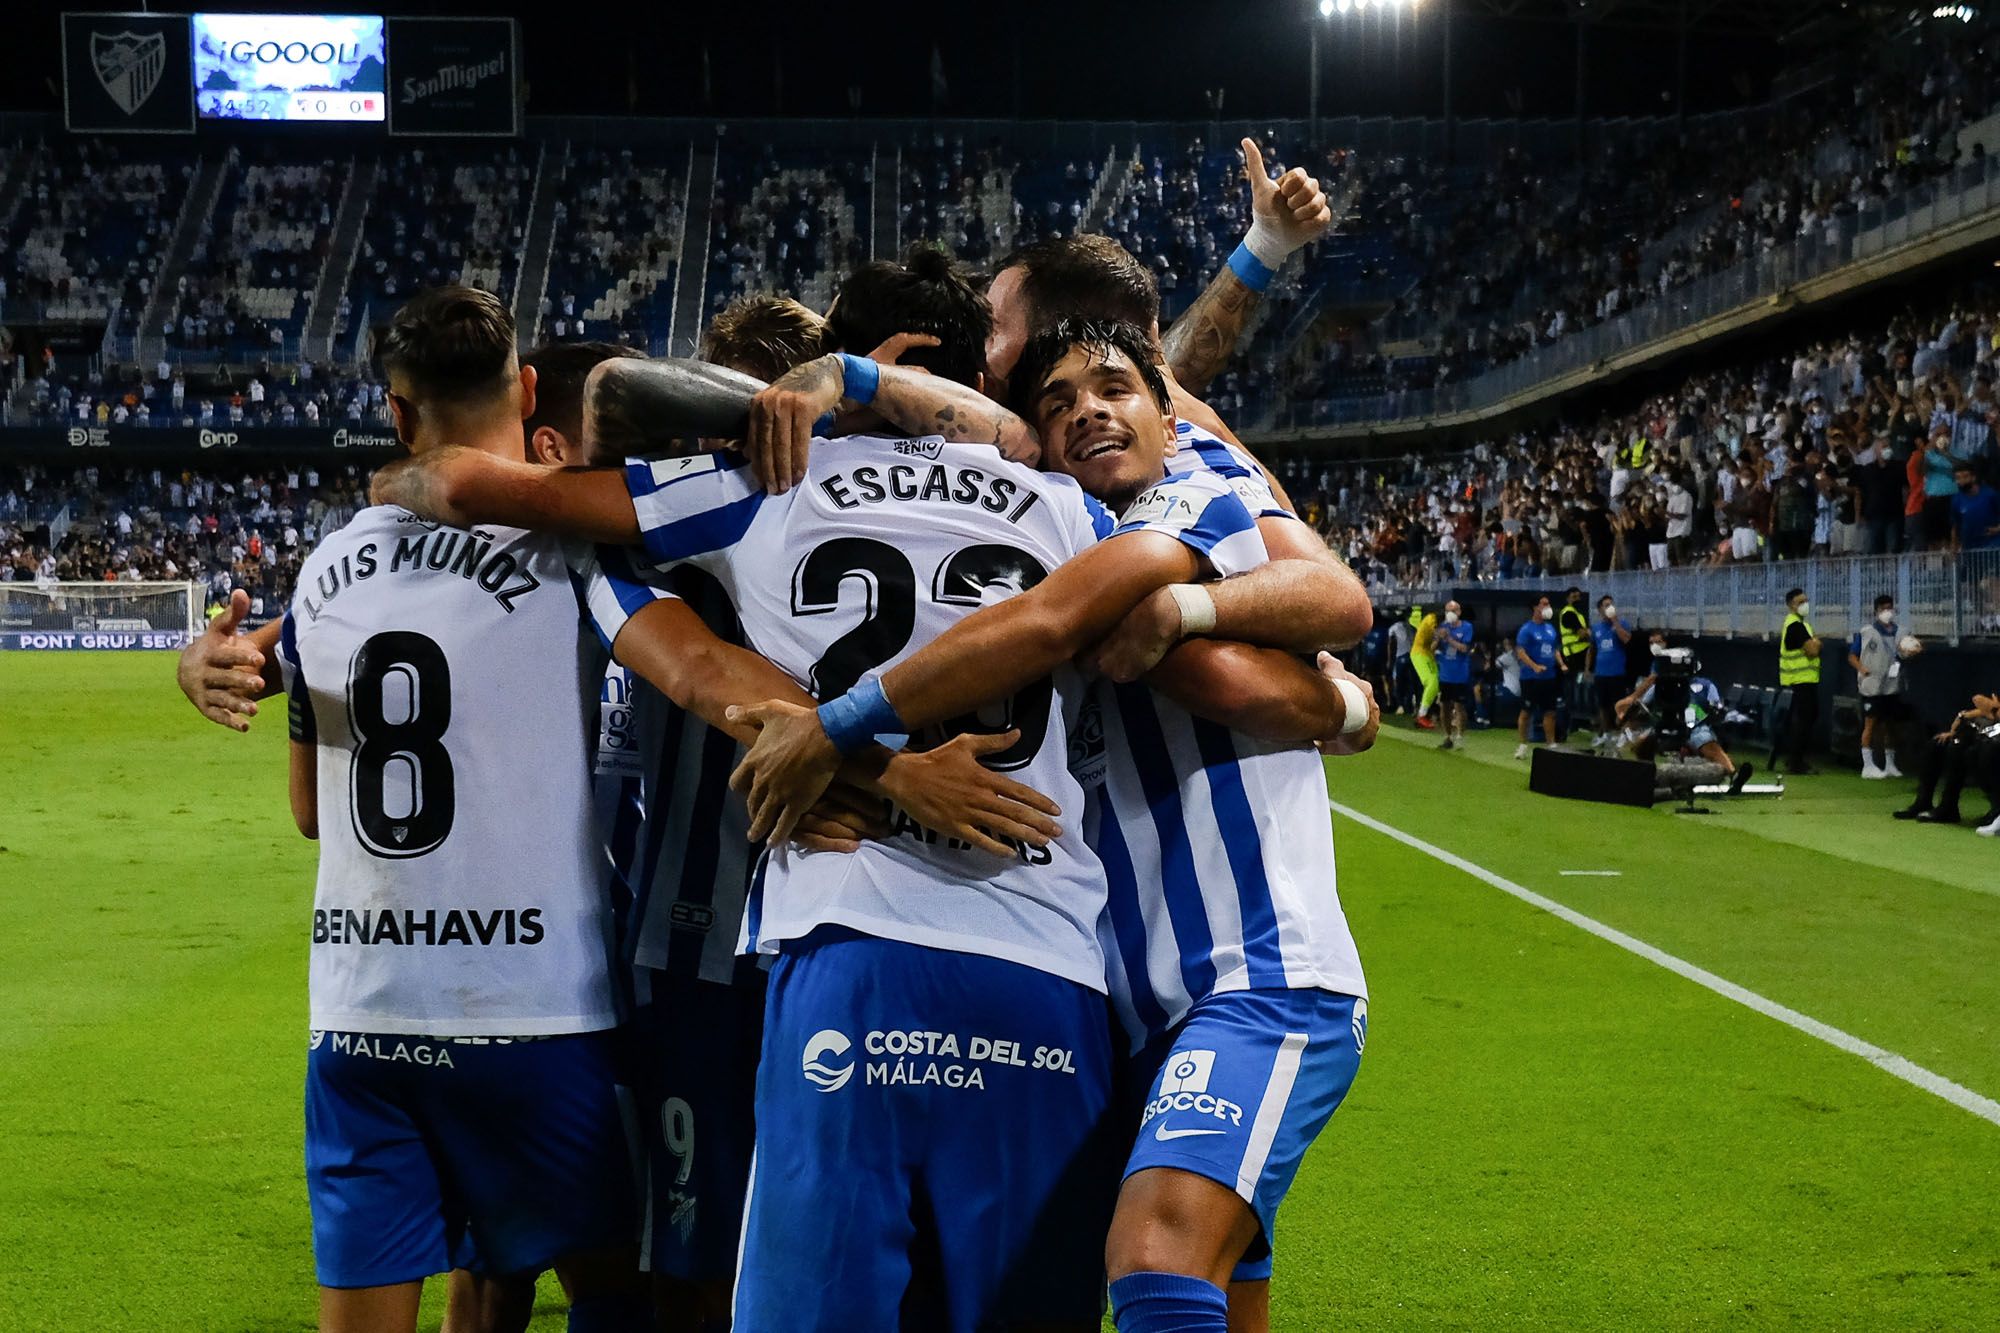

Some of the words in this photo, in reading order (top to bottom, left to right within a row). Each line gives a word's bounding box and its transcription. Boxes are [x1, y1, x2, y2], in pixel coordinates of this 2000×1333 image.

[820, 464, 1039, 524] ESCASSI
[303, 543, 378, 622] LUIS
[390, 530, 541, 614] MUÑOZ
[20, 634, 75, 649] PONT
[346, 630, 456, 860] 8
[313, 908, 545, 946] BENAHAVIS
[332, 1032, 455, 1069] MÁLAGA
[865, 1030, 961, 1059] COSTA
[969, 1037, 1027, 1068] DEL
[1032, 1046, 1076, 1074] SOL
[866, 1056, 985, 1091] MÁLAGA
[661, 1097, 695, 1185] 9
